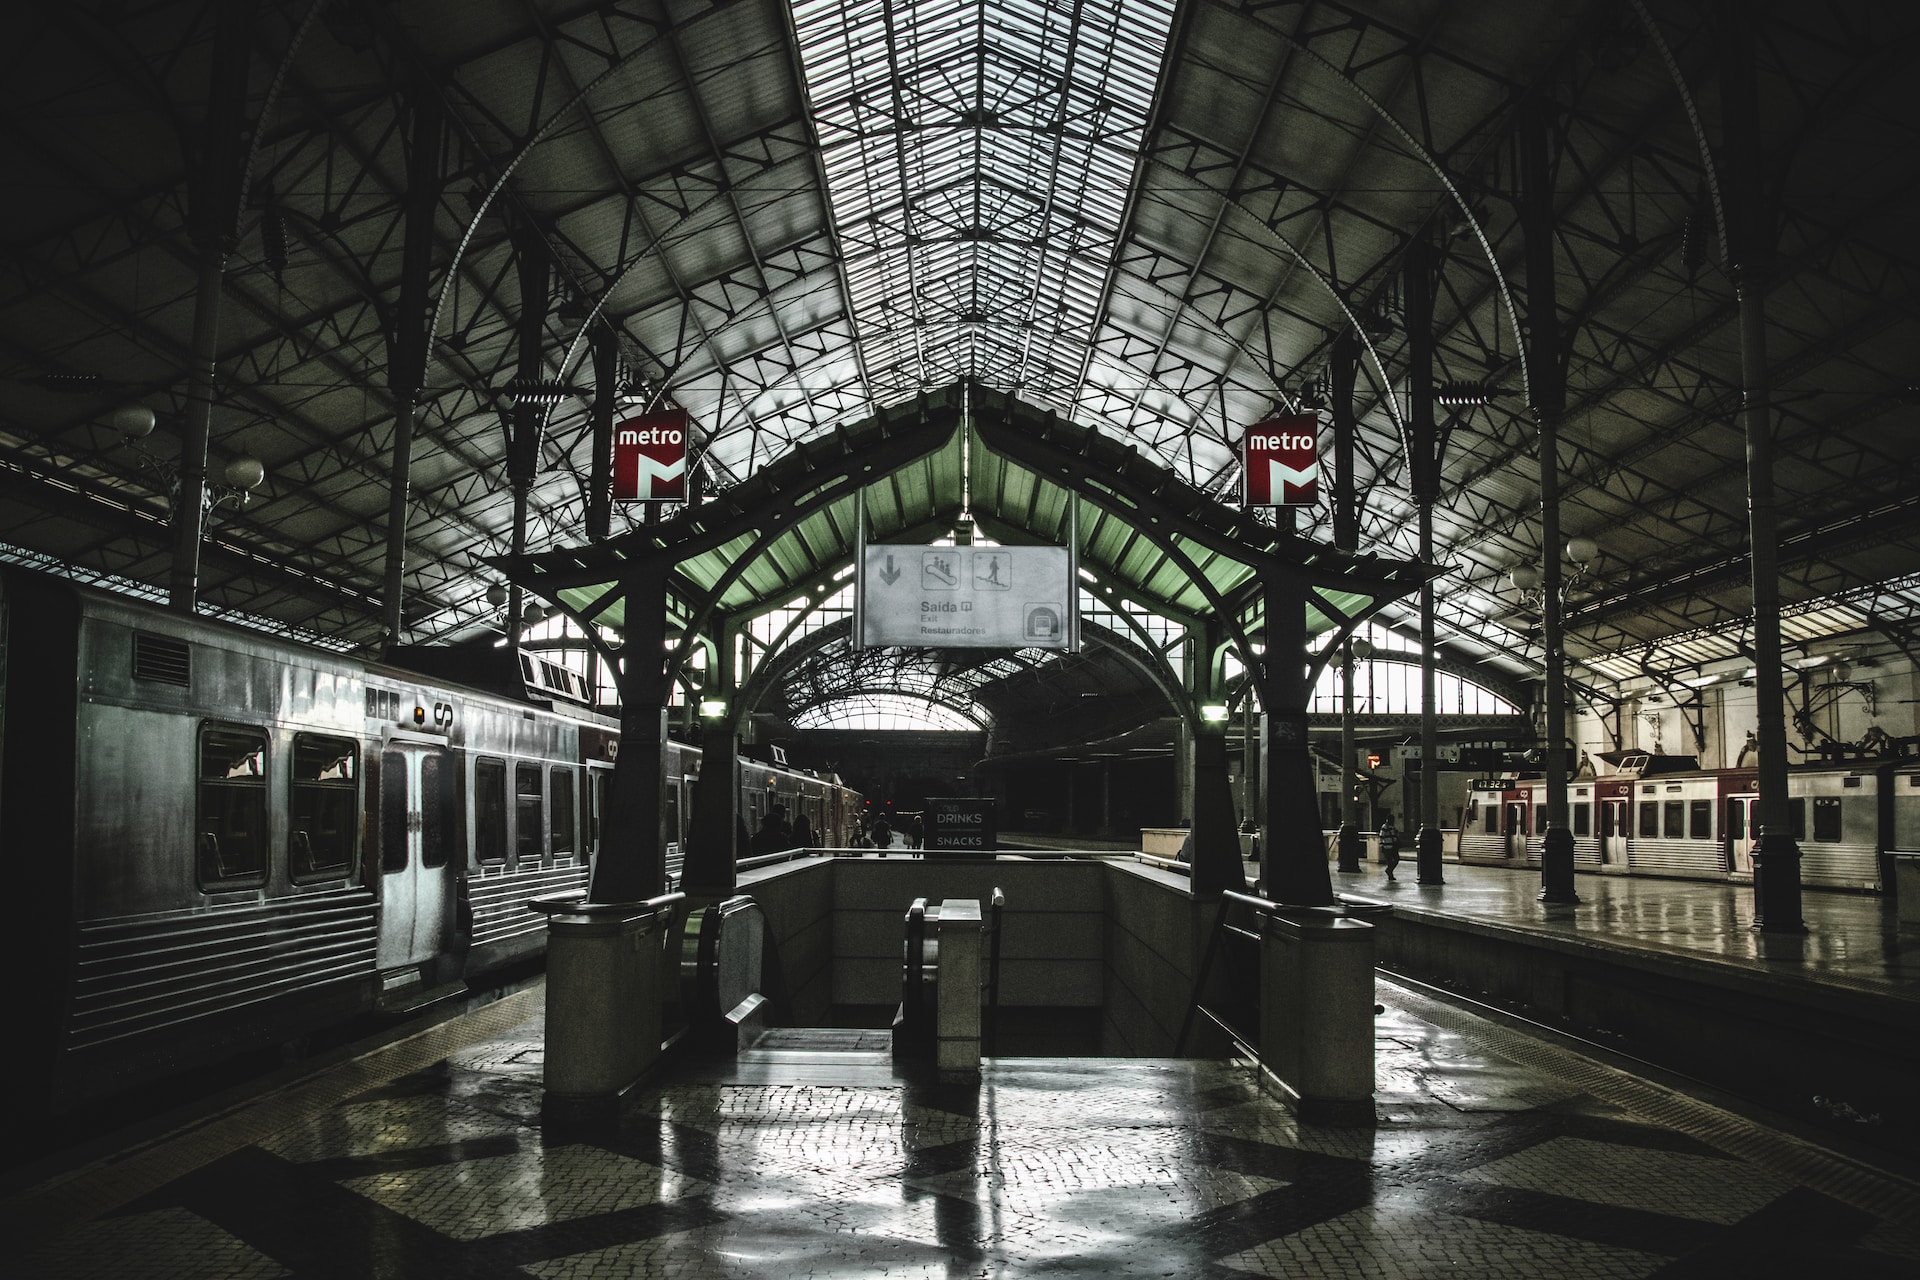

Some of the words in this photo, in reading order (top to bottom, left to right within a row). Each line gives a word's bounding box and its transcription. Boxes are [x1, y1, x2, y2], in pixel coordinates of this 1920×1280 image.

[619, 426, 682, 445] metro
[1250, 431, 1313, 450] metro
[921, 602, 957, 612] Saída
[921, 615, 938, 623] Exit
[921, 627, 986, 635] Restauradores
[937, 813, 982, 824] DRINKS
[937, 836, 982, 846] SNACKS
